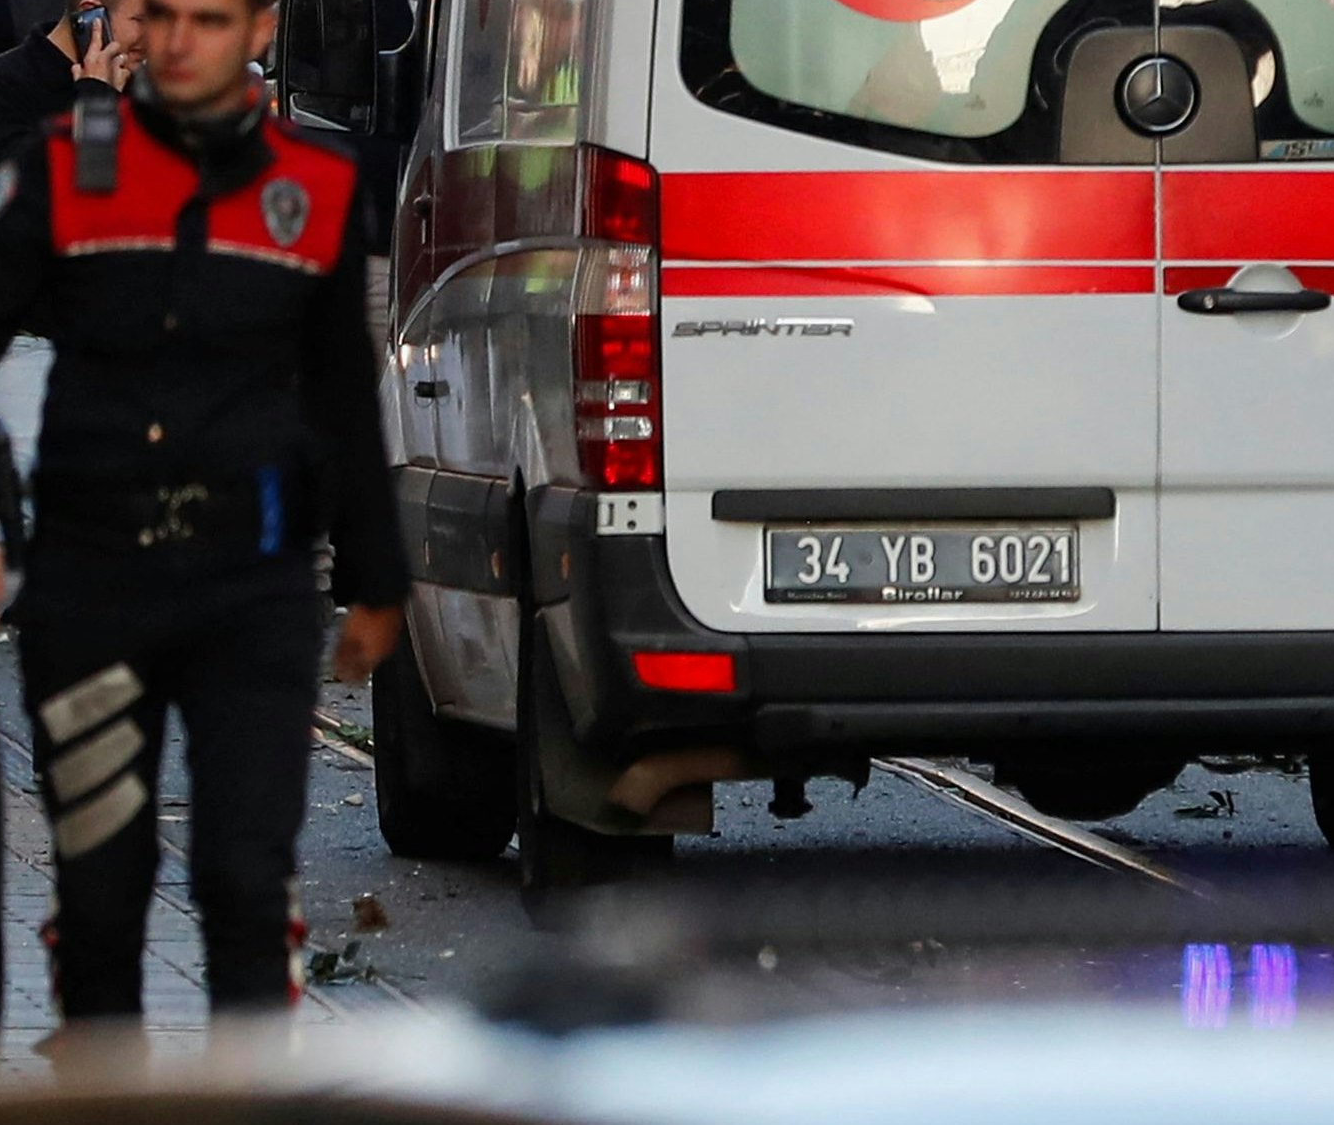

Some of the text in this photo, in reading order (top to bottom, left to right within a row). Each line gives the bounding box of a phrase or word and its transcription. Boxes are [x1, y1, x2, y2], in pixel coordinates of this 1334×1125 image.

[671, 317, 856, 337] SPRINTER
[796, 535, 1071, 584] 34 YB 6021
